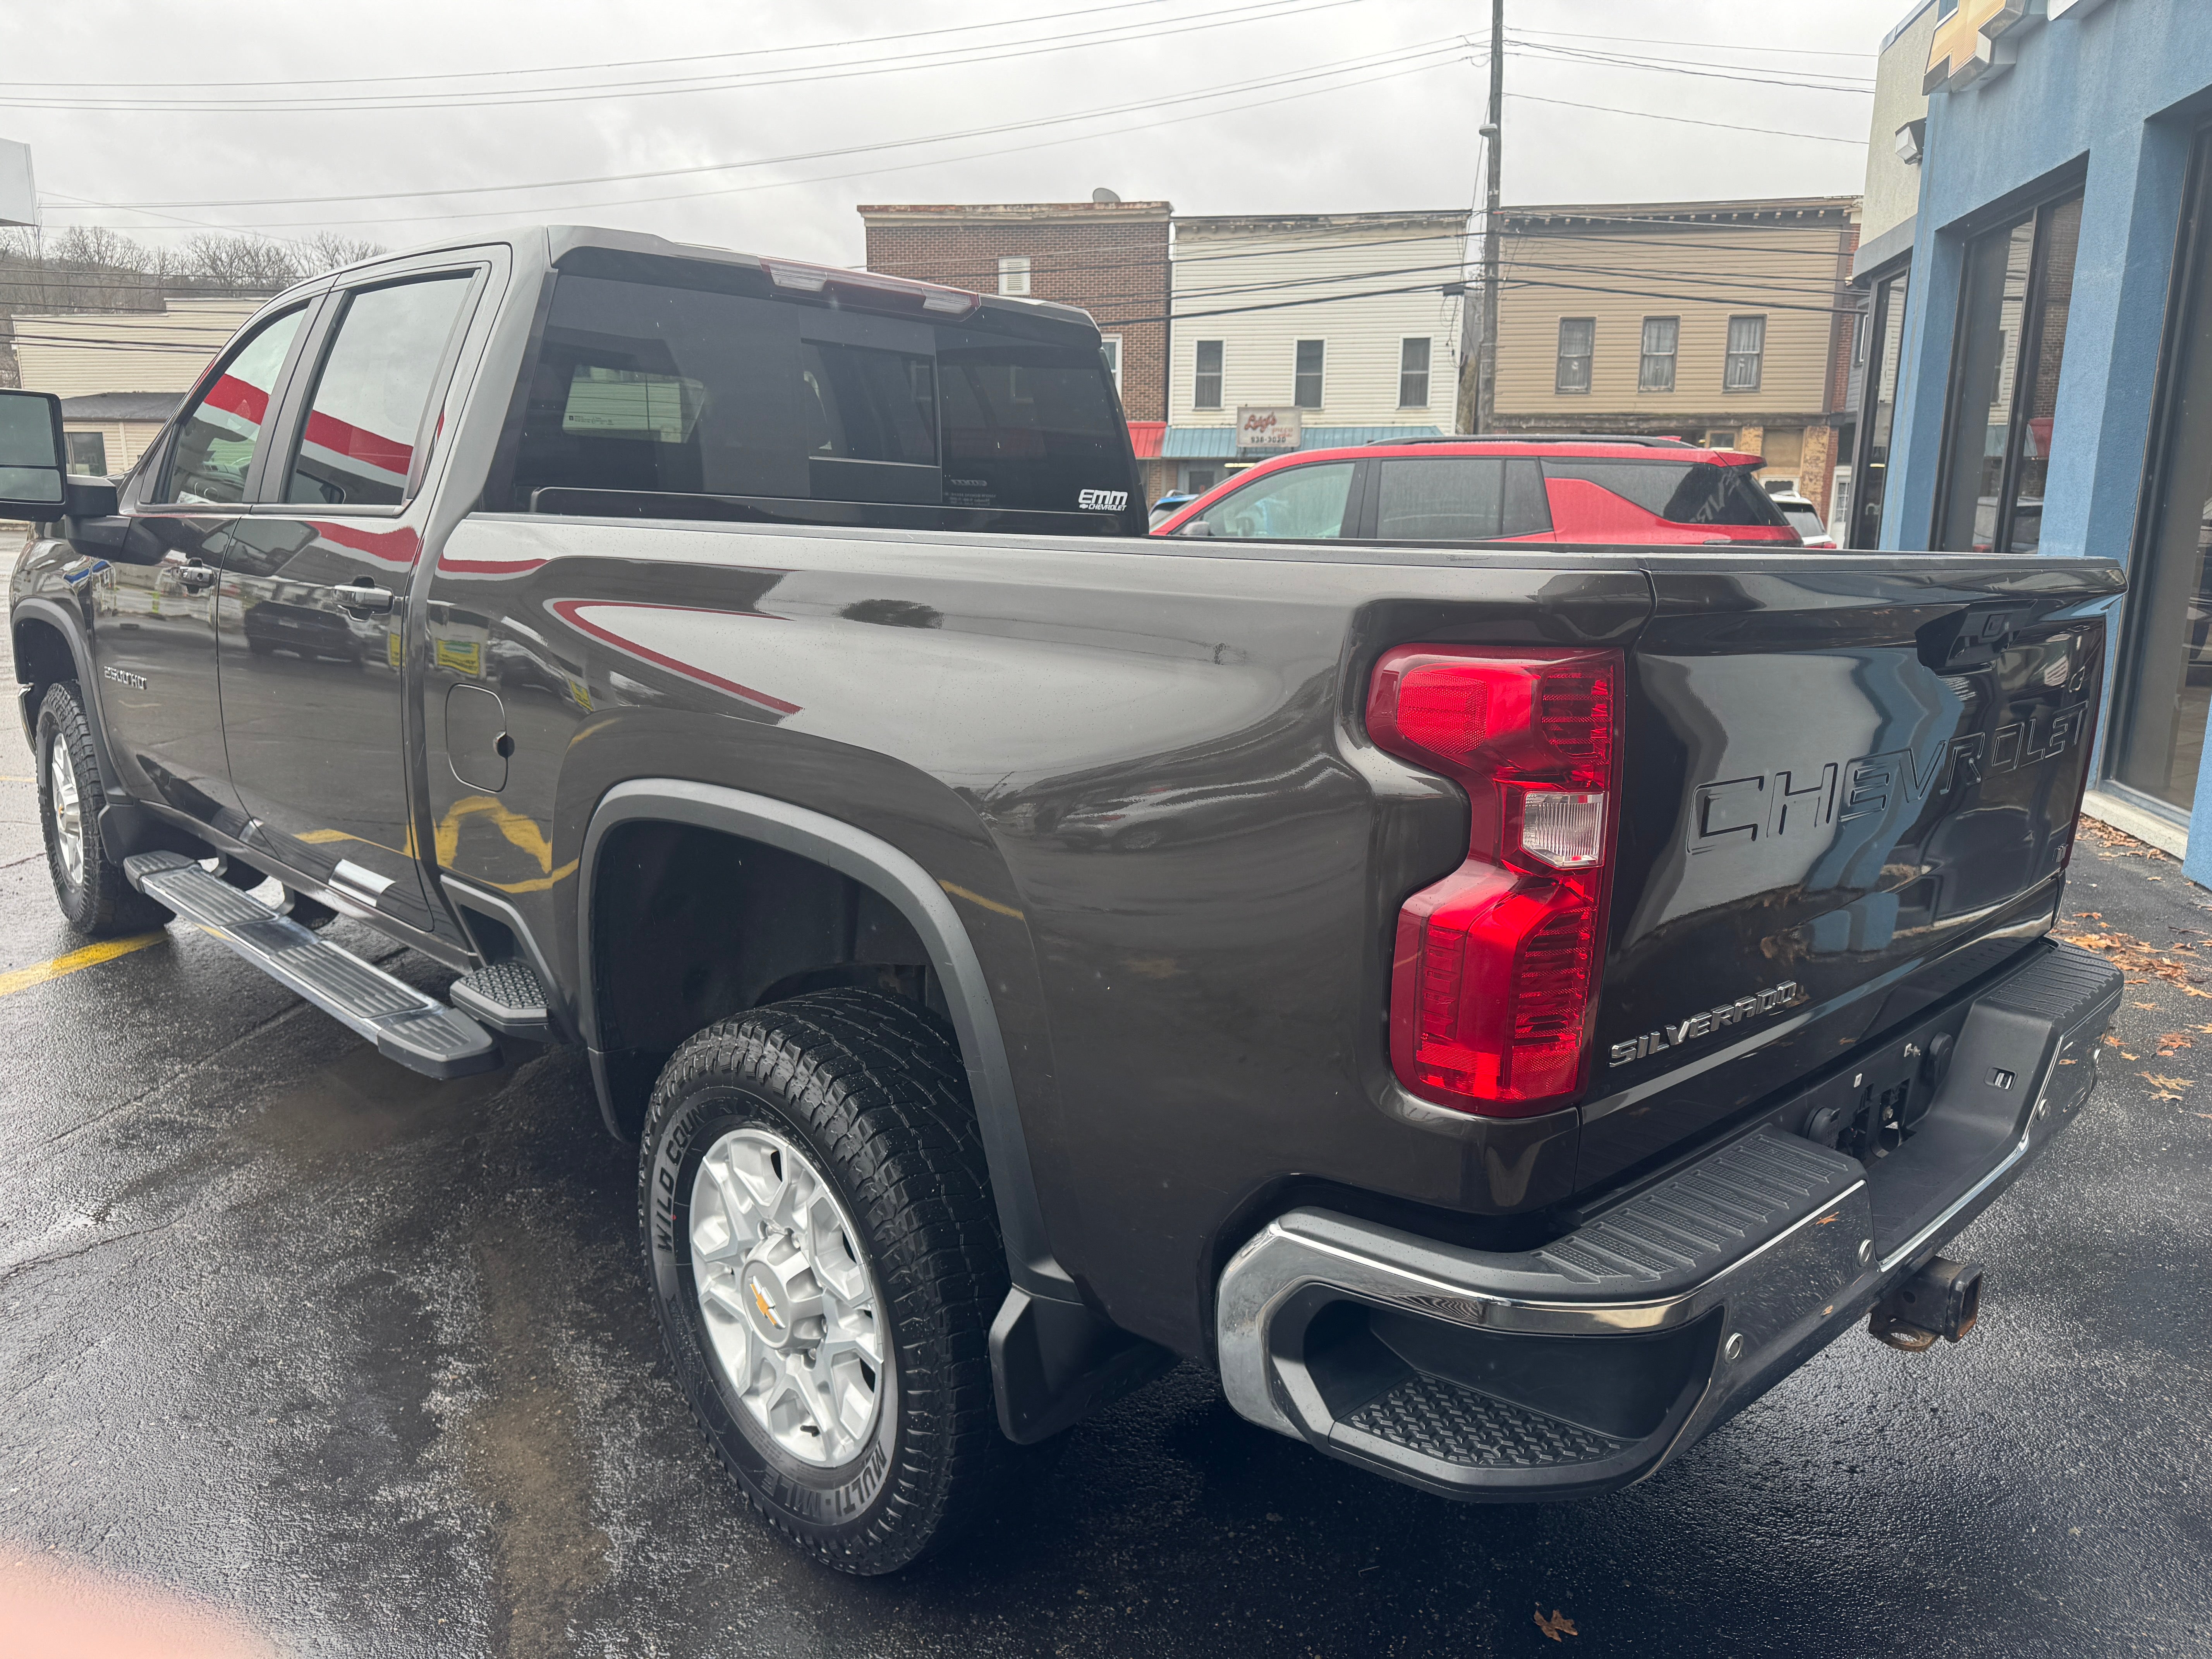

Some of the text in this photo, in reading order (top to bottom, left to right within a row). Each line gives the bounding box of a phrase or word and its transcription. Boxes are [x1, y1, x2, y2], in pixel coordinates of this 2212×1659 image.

[104, 666, 147, 690] 2500HD
[1686, 699, 2089, 855] CHEVROLET
[1608, 980, 1796, 1067] SILVERADO
[657, 1166, 675, 1252] WILD
[666, 1097, 738, 1166] COUNTRY
